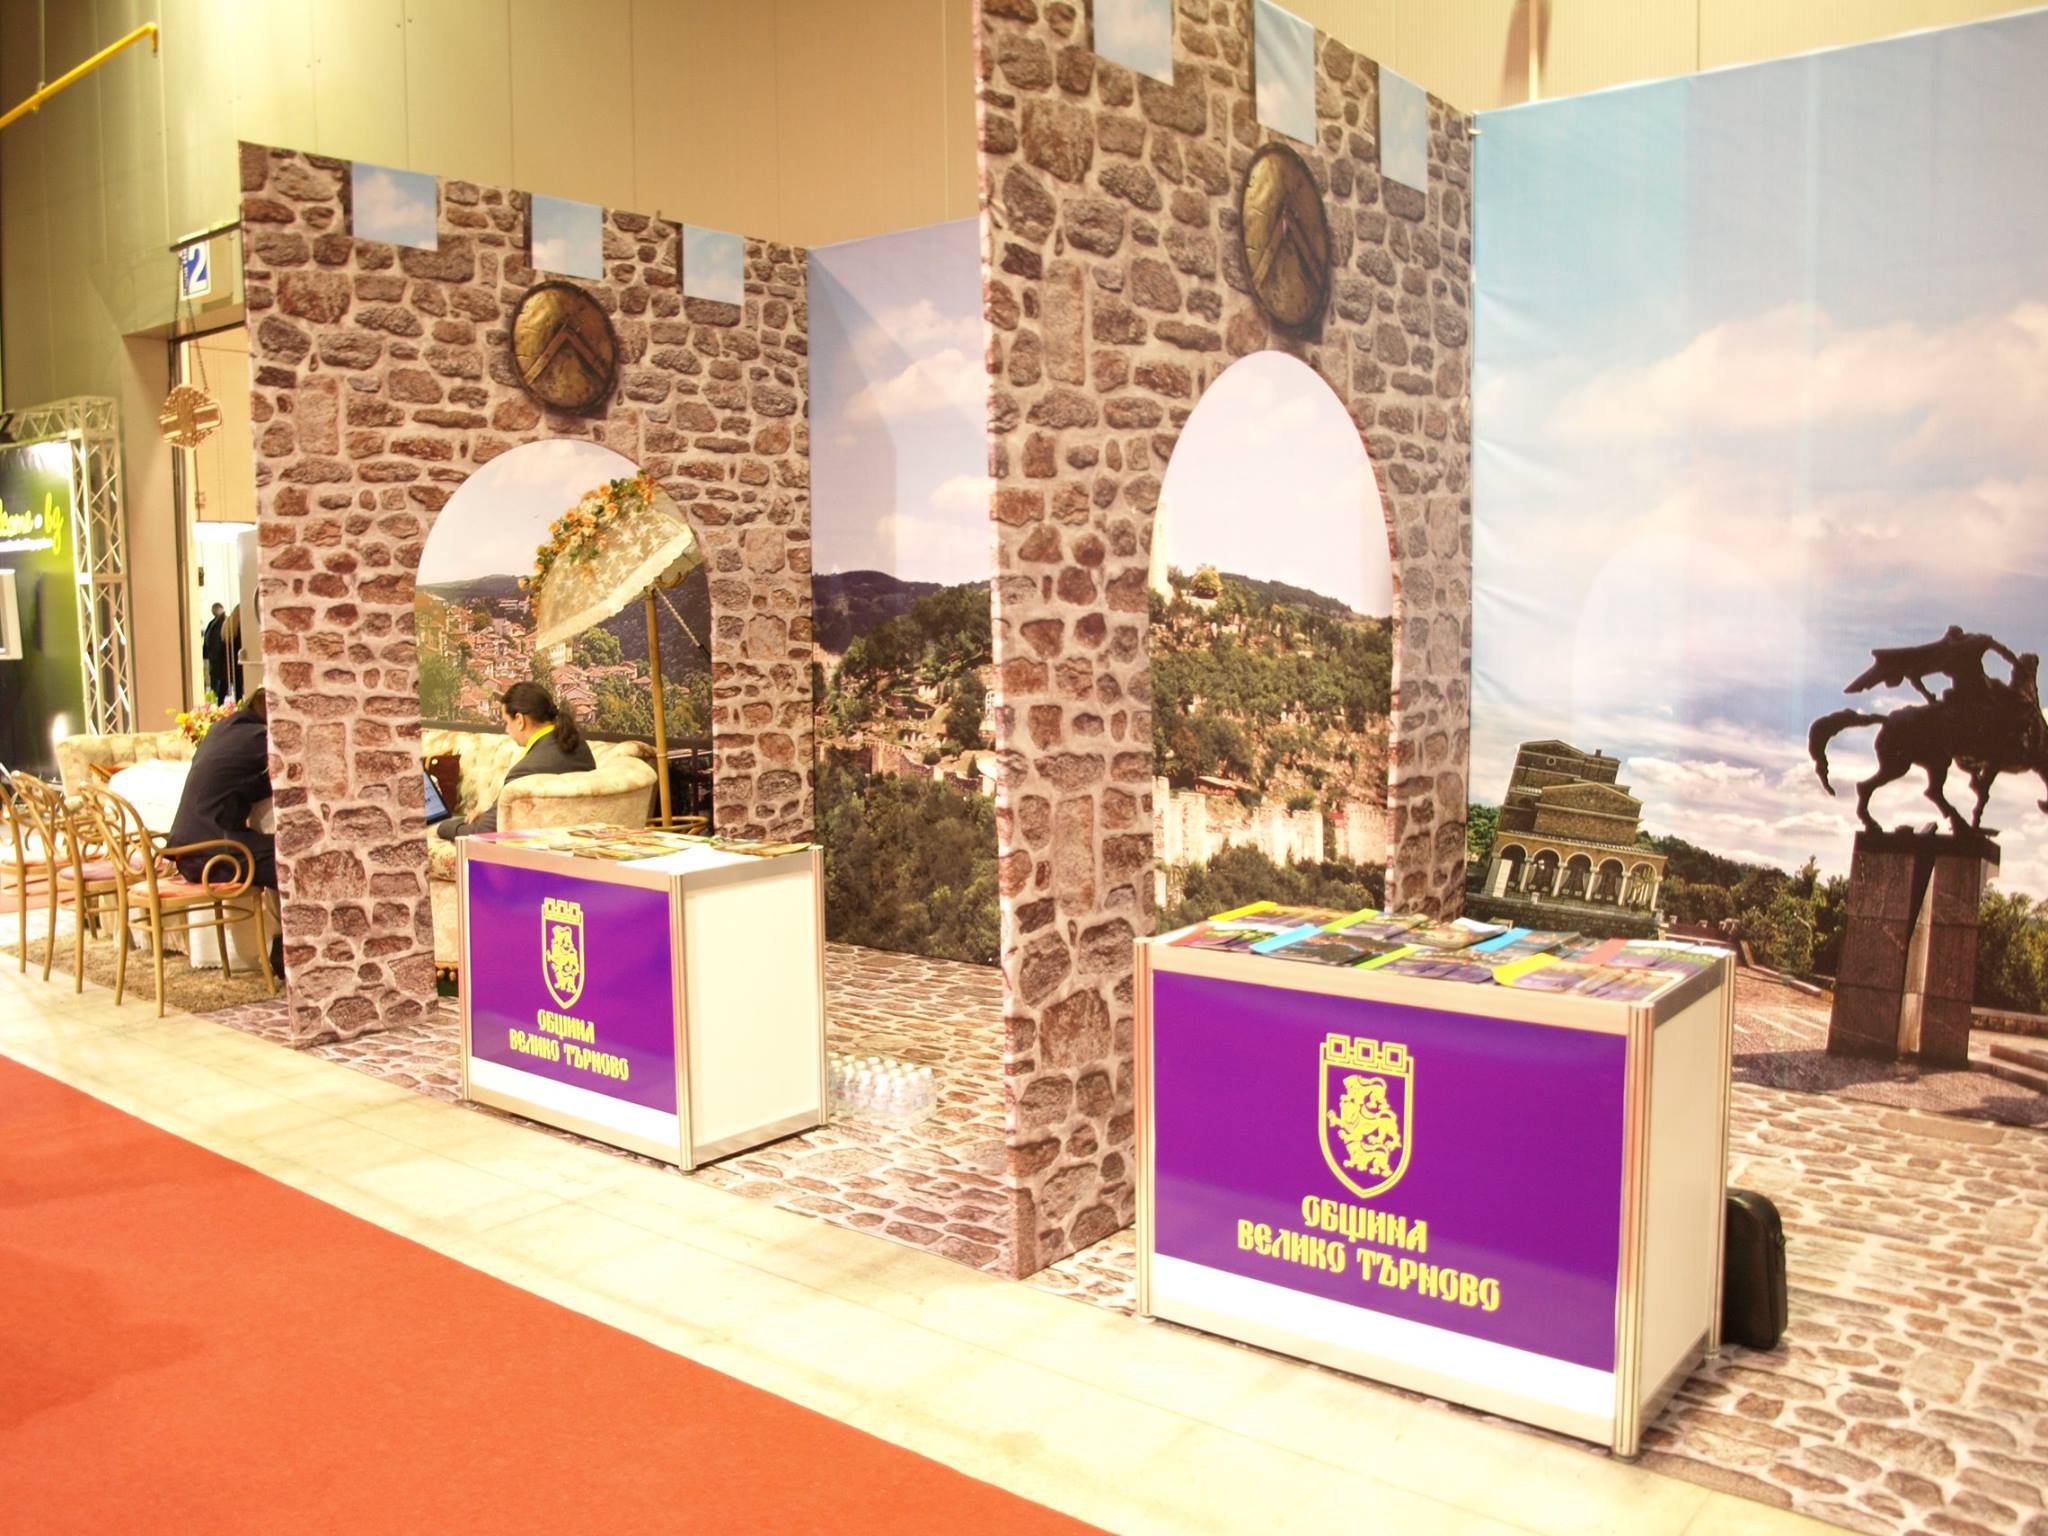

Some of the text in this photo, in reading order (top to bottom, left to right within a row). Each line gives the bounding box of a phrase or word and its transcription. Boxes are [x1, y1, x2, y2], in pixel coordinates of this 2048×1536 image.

[188, 242, 208, 293] 2
[537, 1009, 595, 1044] ОБЩИНА
[509, 1028, 629, 1081] ВЕЛИКО ТЪРНОВО
[1301, 1195, 1428, 1253] ОБЩИНА
[1237, 1219, 1500, 1312] ВЕЛИКО ТЪРНОВО
